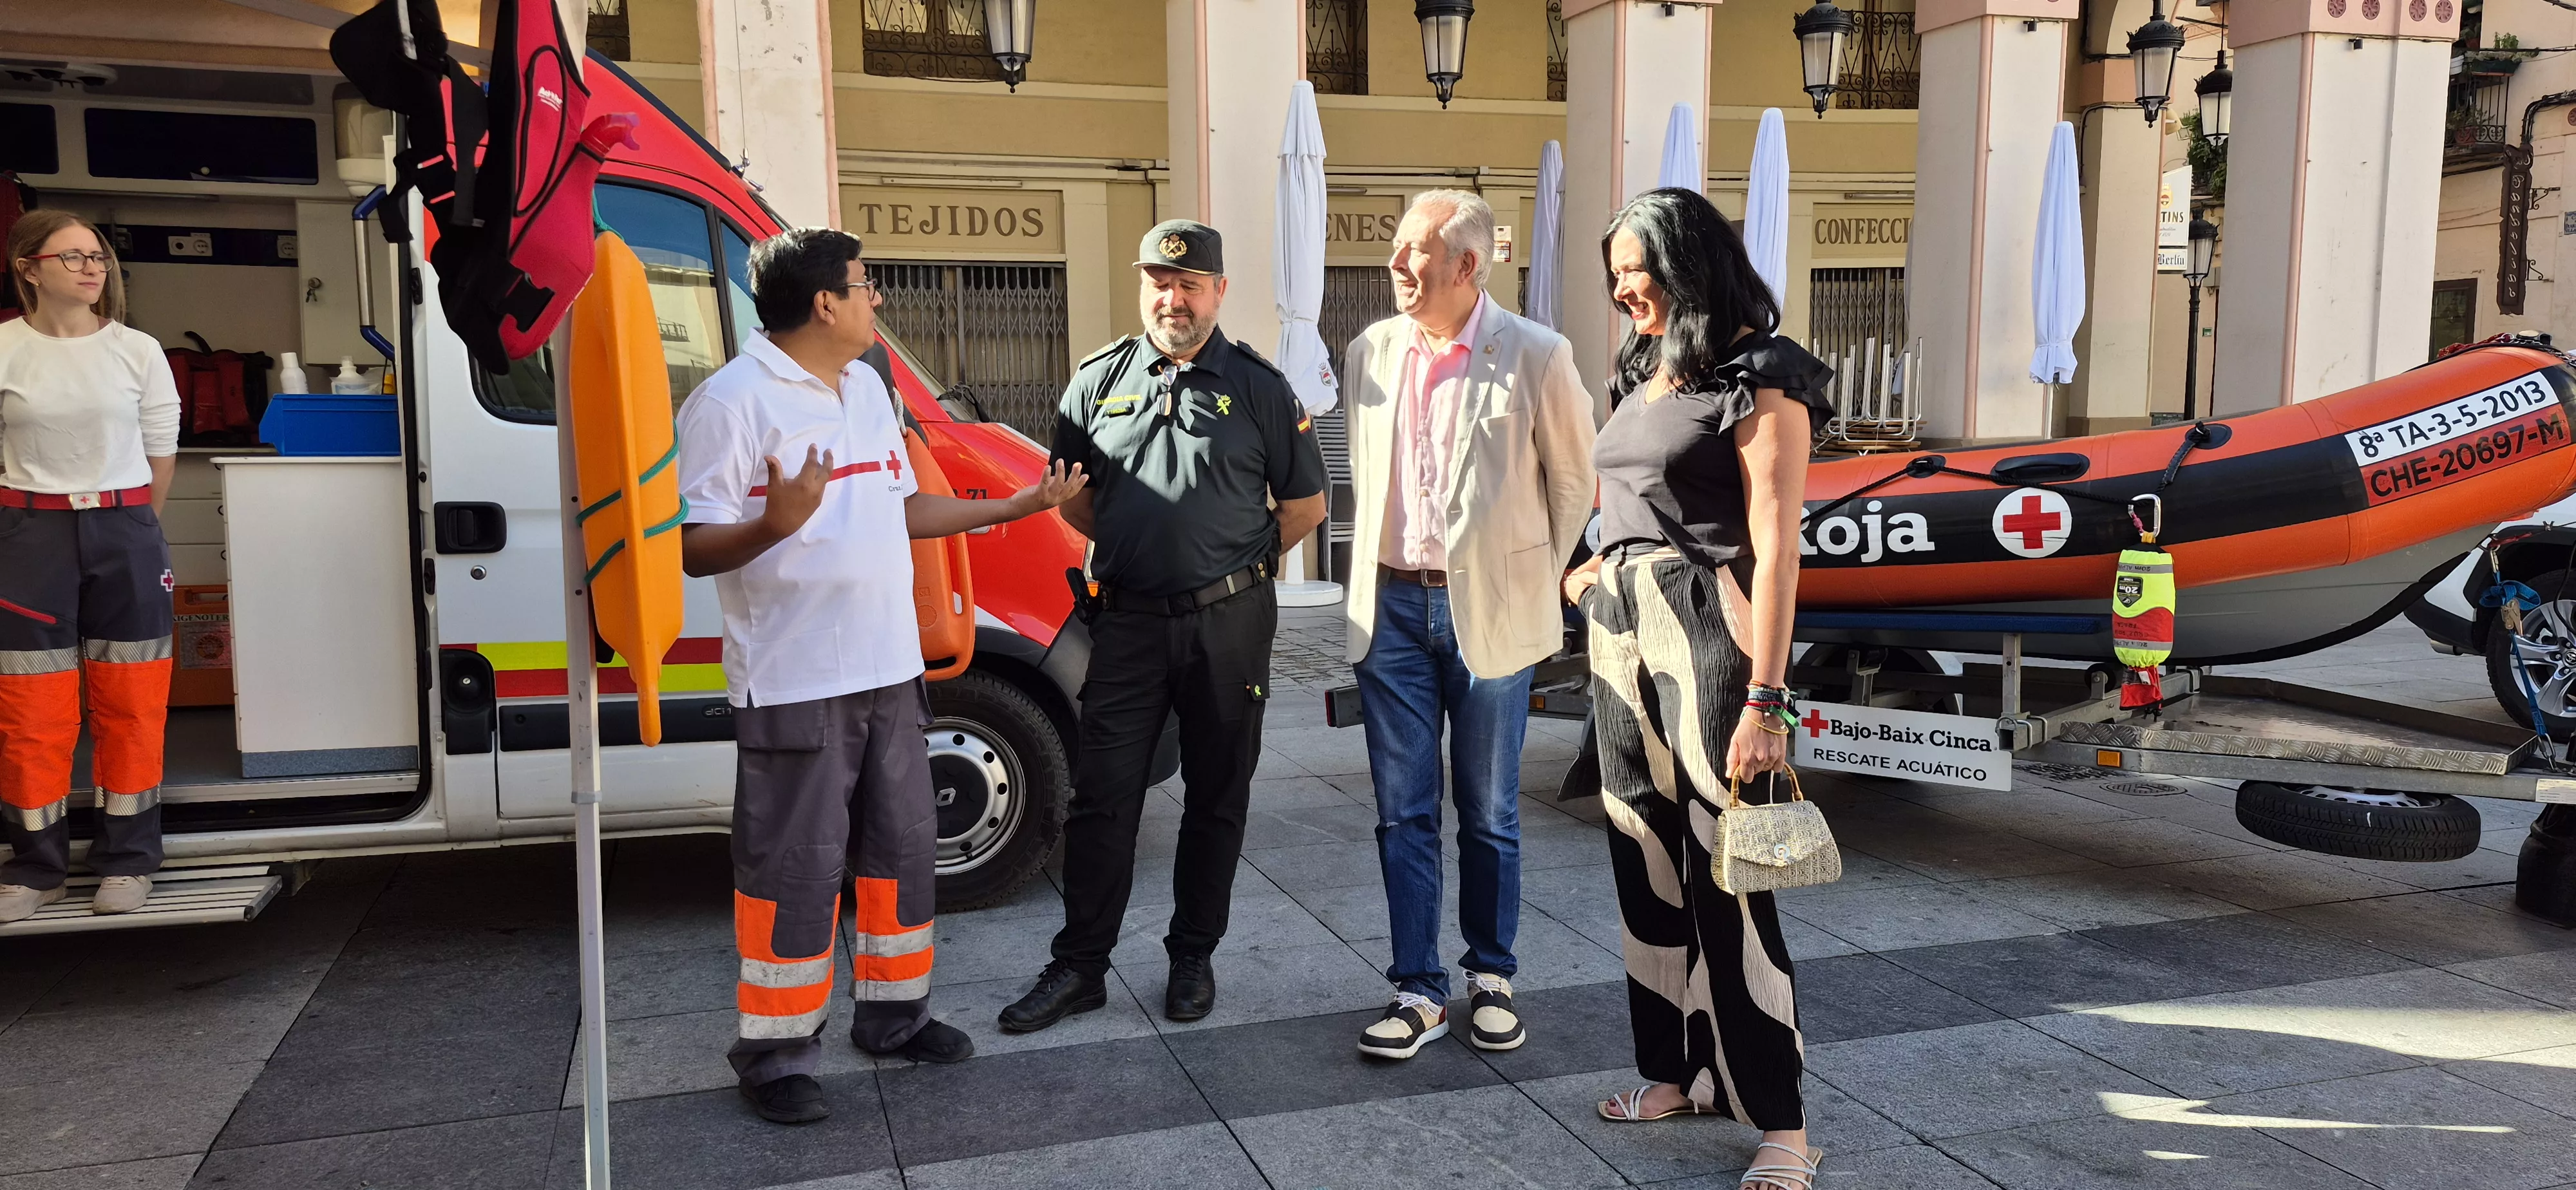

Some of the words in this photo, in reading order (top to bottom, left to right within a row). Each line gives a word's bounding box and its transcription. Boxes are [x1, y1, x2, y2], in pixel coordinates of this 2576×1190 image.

[858, 203, 1044, 238] TEJIDOS
[1815, 218, 1913, 245] CONFECCI
[2160, 211, 2184, 223] TINS
[2388, 380, 2546, 448] TA-3-5-2013
[2371, 412, 2564, 497] CHE-20697-M
[2119, 585, 2138, 594] 20m
[1830, 719, 1924, 745] Bajo-Baix
[1929, 729, 1992, 752] Cinca
[1814, 748, 1891, 769] RESCATE
[1897, 759, 1987, 782] ACUÁTICO
